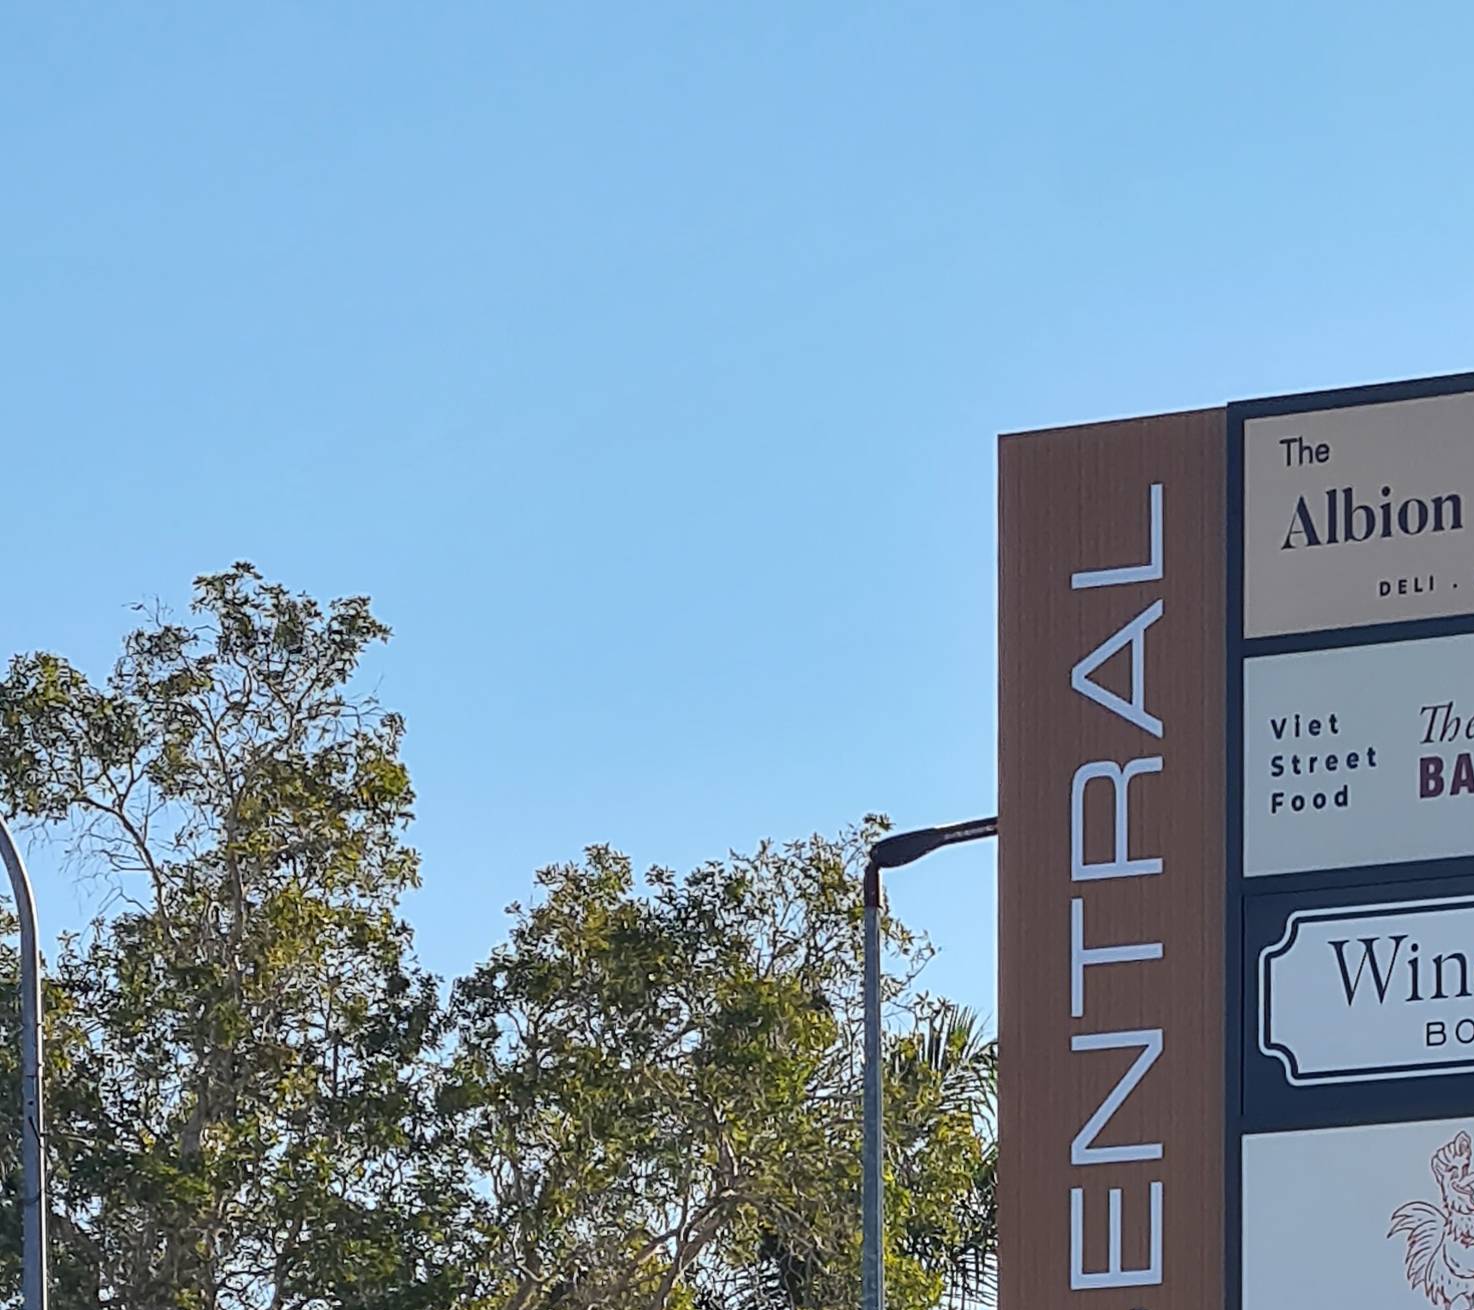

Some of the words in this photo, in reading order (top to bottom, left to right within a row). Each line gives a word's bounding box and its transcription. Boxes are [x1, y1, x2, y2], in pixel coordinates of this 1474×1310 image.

[1278, 436, 1330, 467] The
[1281, 486, 1463, 550] Albion
[1379, 575, 1434, 597] DELI
[1270, 713, 1339, 740] Viet
[1270, 746, 1377, 778] Street
[1271, 784, 1348, 814] Food
